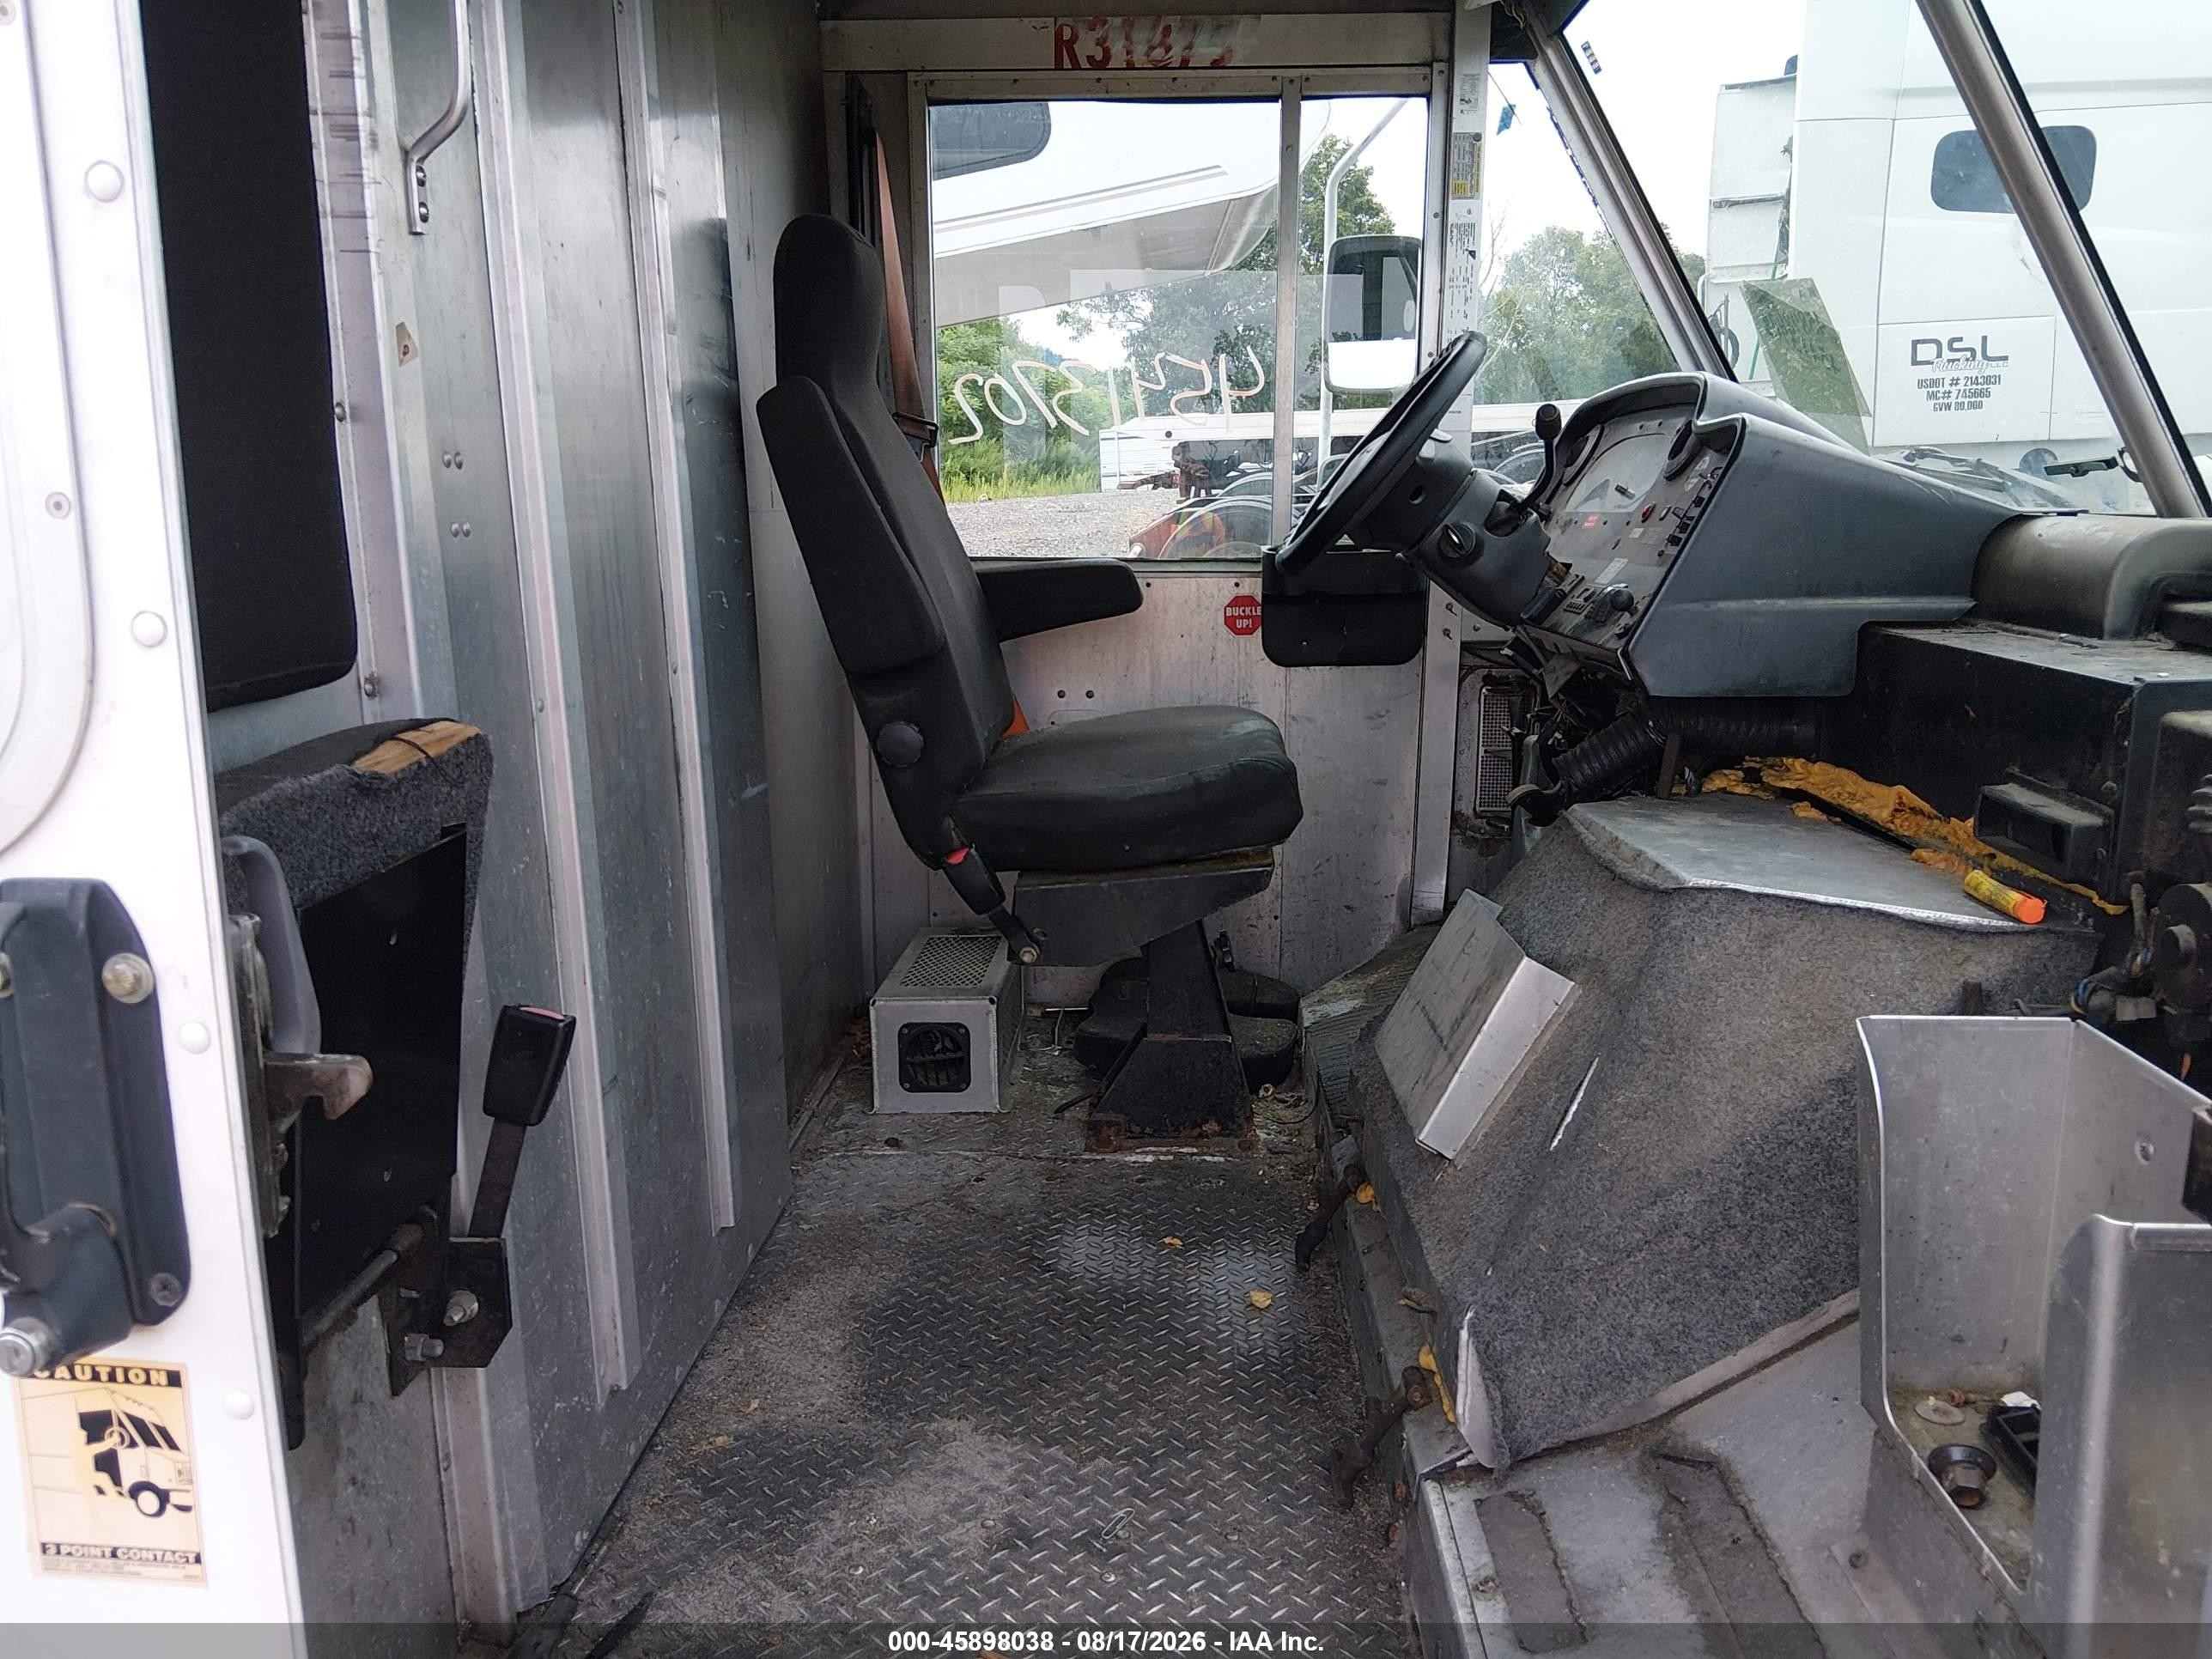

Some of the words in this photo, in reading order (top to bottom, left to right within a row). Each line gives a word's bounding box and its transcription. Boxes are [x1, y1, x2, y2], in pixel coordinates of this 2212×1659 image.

[1911, 335, 2009, 366] DSL
[1917, 378, 1946, 389] USDOT
[1948, 376, 1961, 387] #
[1963, 374, 2002, 386] 2143031
[1926, 389, 1953, 401] MC#
[1955, 387, 1991, 399] 745665
[1933, 402, 1952, 411] GVW
[1225, 606, 1262, 617] BUCKLE
[1236, 618, 1253, 629] UP!
[60, 1546, 112, 1559] POINT
[116, 1548, 197, 1565] CONTACT
